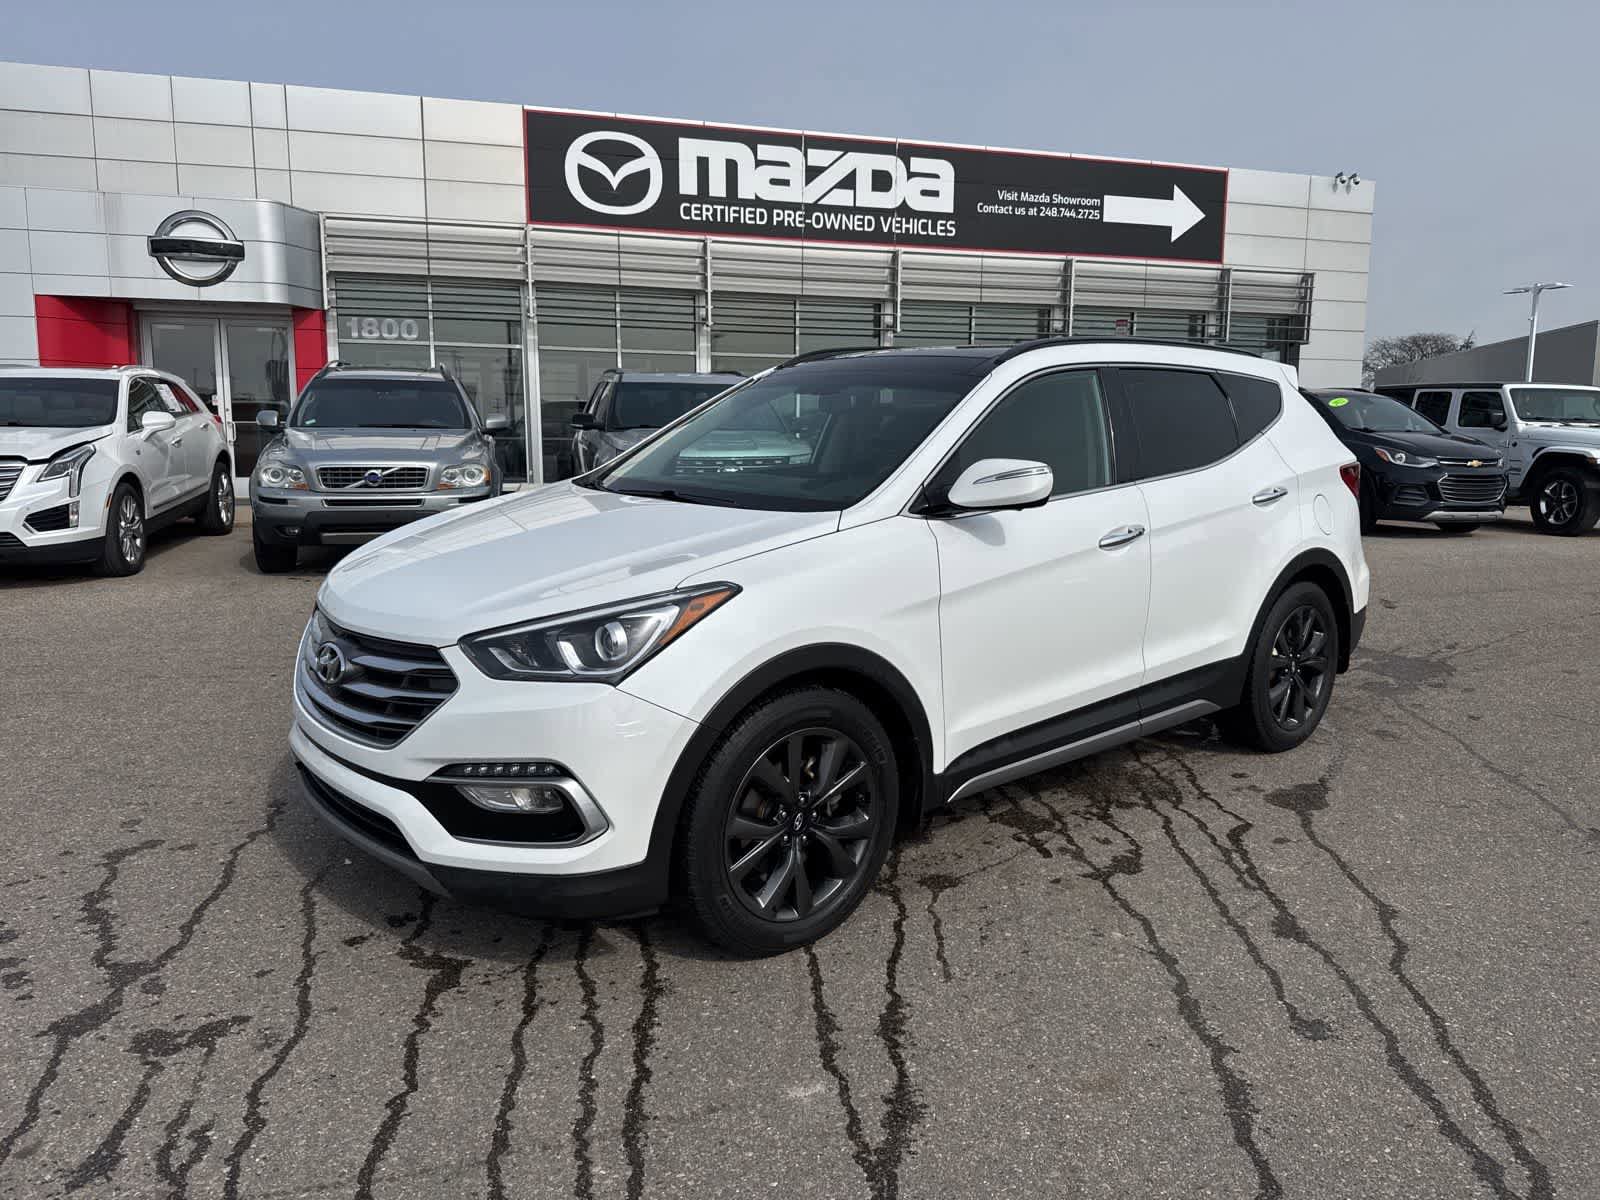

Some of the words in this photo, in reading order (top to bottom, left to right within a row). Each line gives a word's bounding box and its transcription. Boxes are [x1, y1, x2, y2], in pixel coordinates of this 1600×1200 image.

[997, 189, 1018, 201] Visit
[1020, 191, 1050, 204] Mazda
[1051, 194, 1101, 206] Showroom
[680, 202, 768, 225] CERTIFIED
[772, 208, 875, 232] PRE-OWNED
[880, 216, 956, 237] VEHICLES
[977, 202, 1013, 214] Contact
[1015, 207, 1026, 216] us
[1028, 207, 1038, 216] at
[1039, 206, 1100, 219] 248.744.2725
[346, 317, 419, 340] 1800
